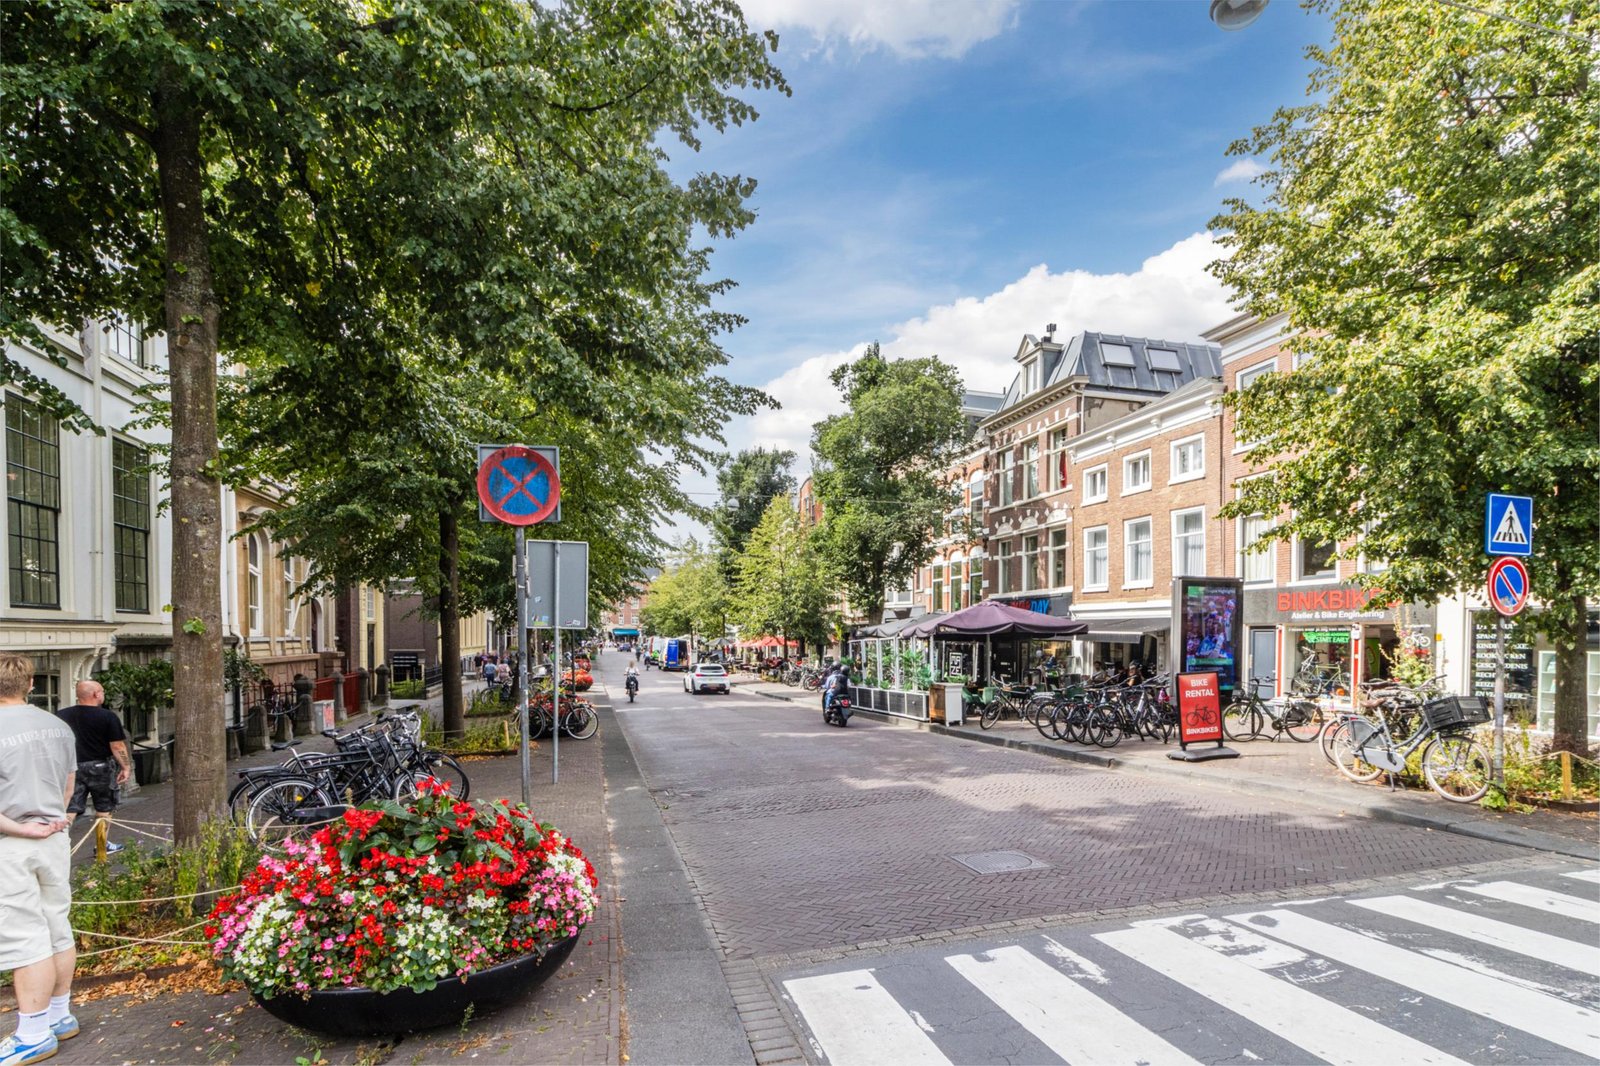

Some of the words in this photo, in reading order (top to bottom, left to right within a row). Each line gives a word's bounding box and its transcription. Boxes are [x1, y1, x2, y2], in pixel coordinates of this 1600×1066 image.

[1291, 611, 1314, 619] Atelier
[1314, 611, 1320, 619] &
[1321, 610, 1338, 619] Bike
[1190, 678, 1209, 687] BIKE
[1185, 688, 1215, 698] RENTAL
[1186, 726, 1219, 735] BINKBIKES
